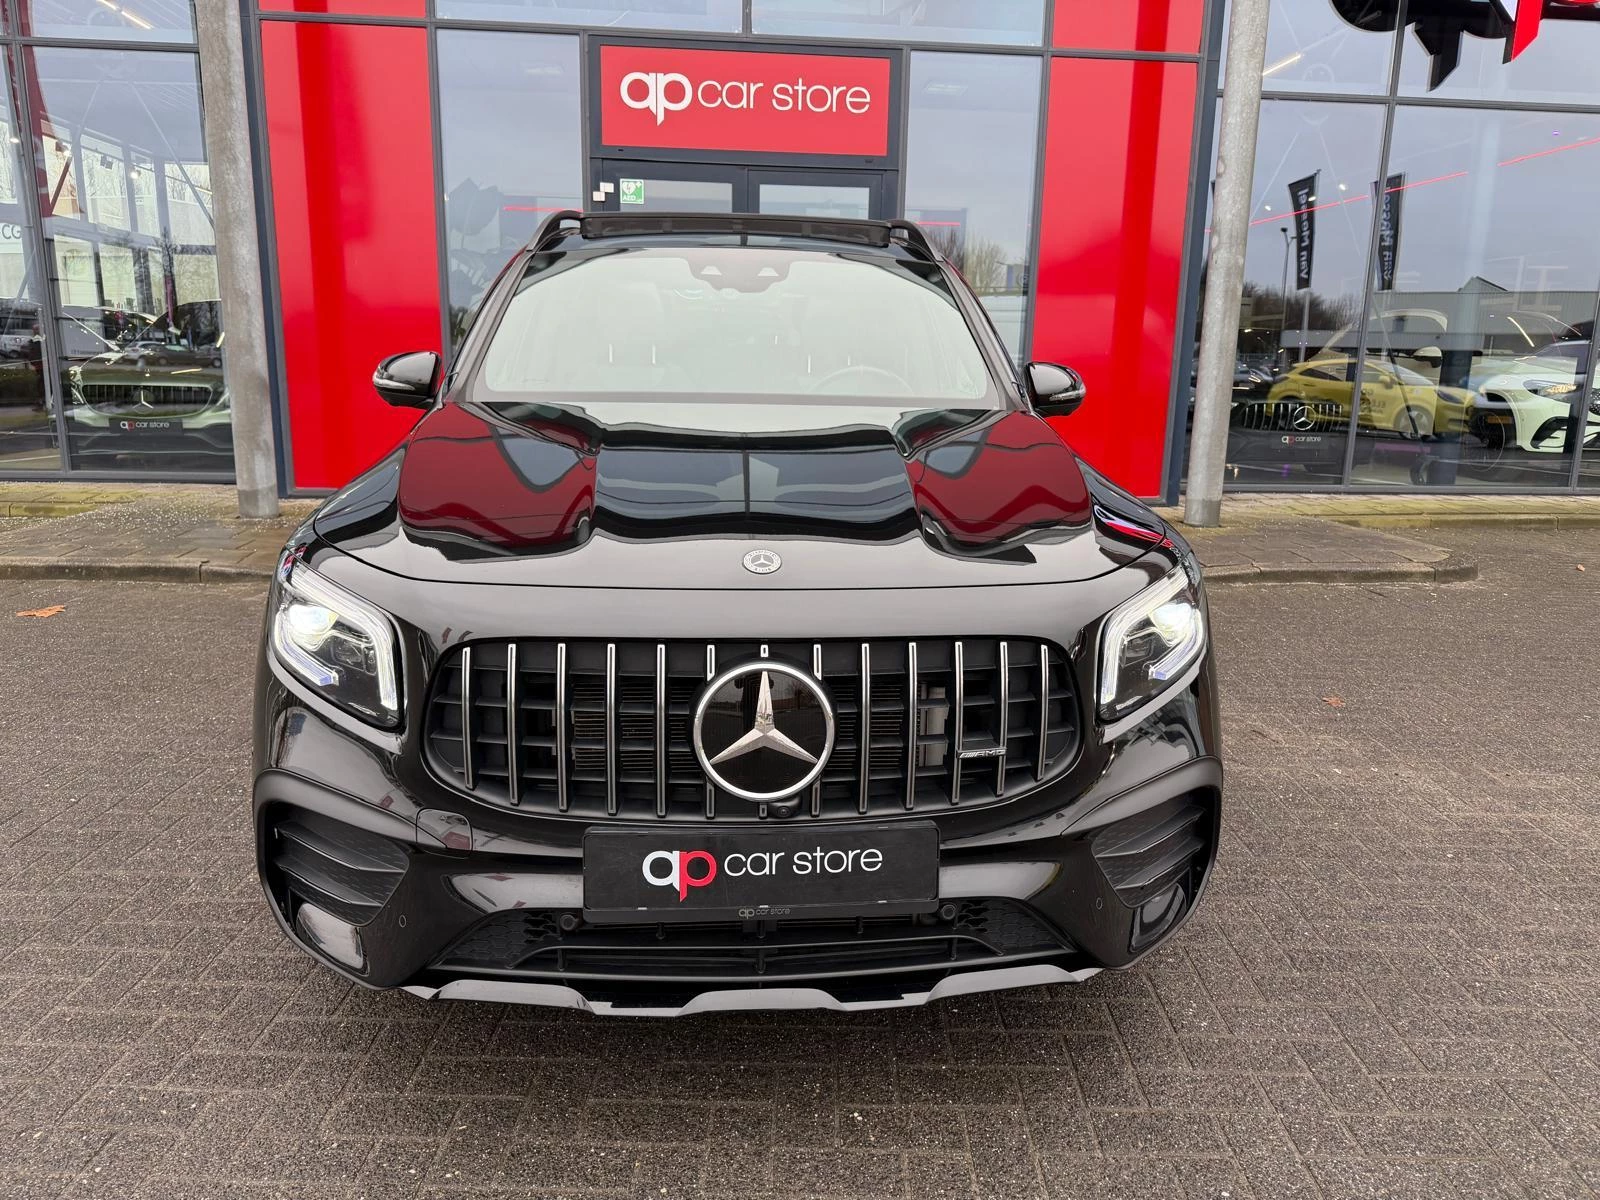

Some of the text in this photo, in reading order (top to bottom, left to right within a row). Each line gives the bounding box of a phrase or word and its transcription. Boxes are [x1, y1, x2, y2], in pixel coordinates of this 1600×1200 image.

[620, 71, 871, 126] ap car store
[642, 846, 884, 903] ap car store
[770, 907, 791, 915] store
